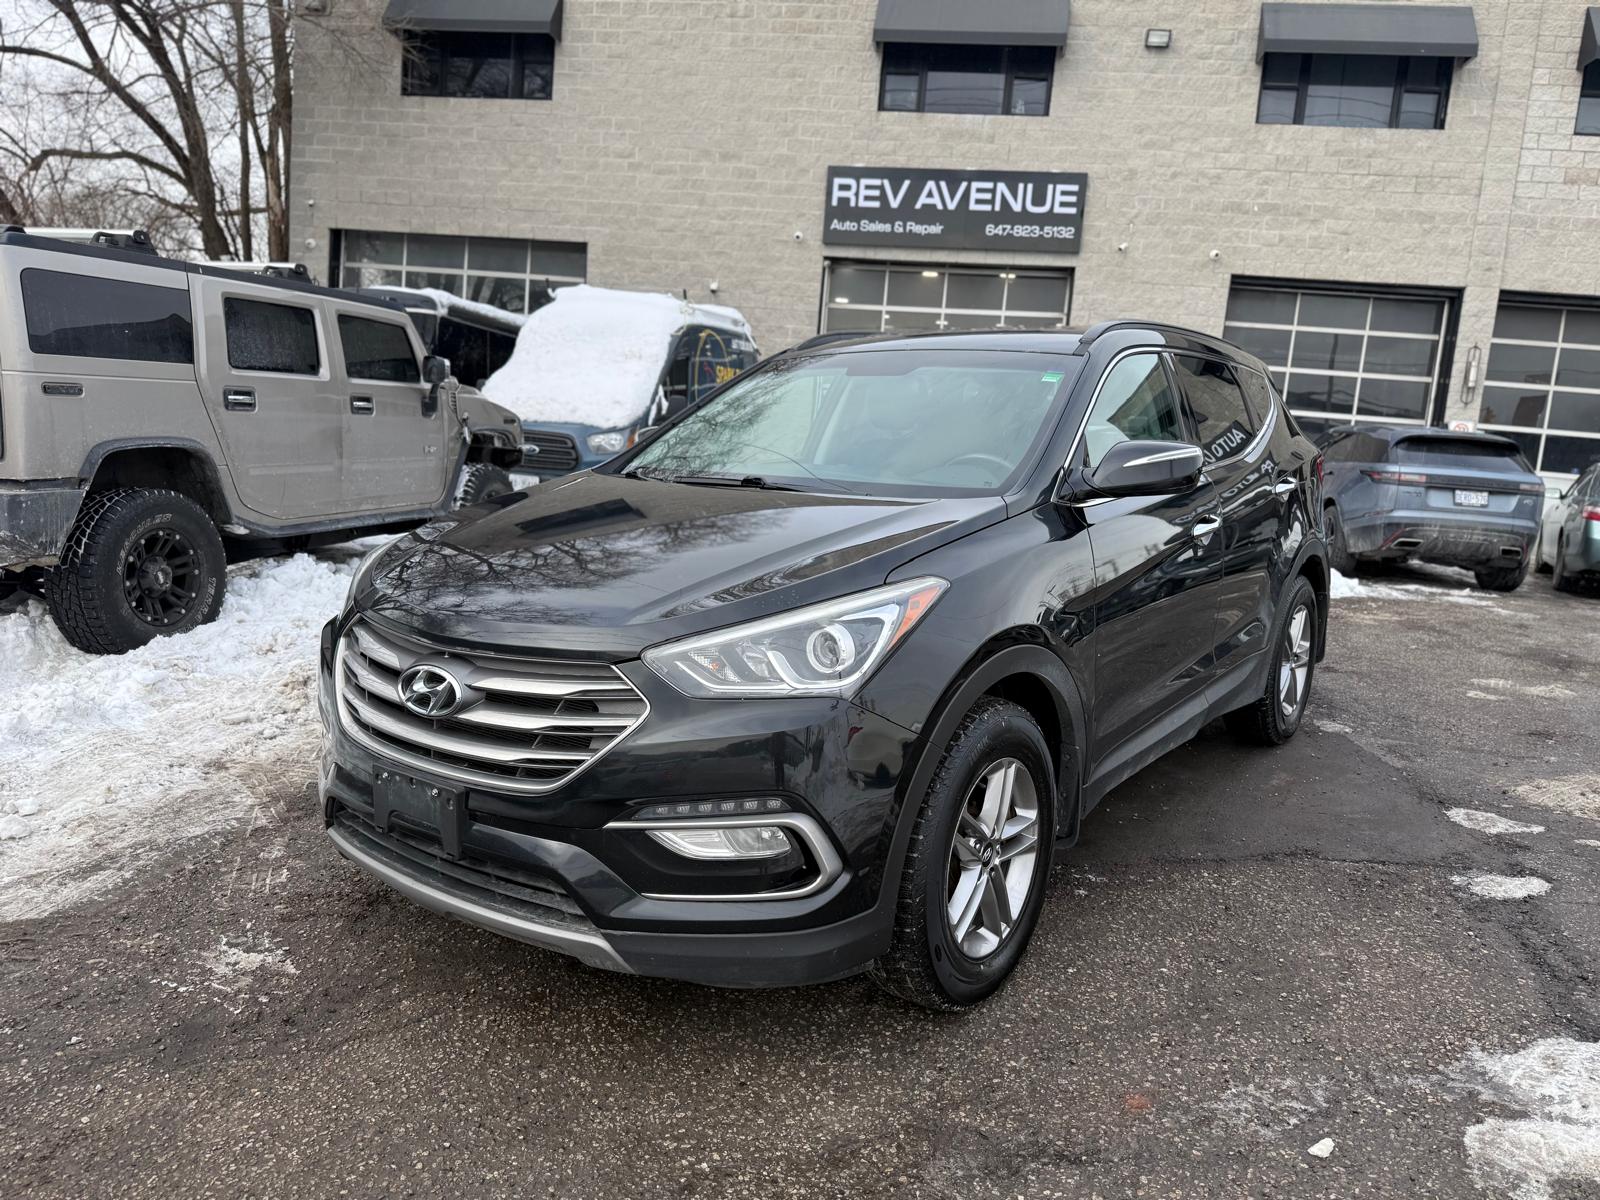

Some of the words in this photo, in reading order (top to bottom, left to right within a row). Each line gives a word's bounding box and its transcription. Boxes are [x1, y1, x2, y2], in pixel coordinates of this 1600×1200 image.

[831, 177, 911, 209] REV
[914, 180, 1079, 214] AVENUE
[830, 219, 858, 231] Auto
[859, 220, 892, 232] Sales
[893, 221, 904, 233] &
[906, 221, 944, 235] Repair
[985, 224, 1075, 238] 647-823-5132
